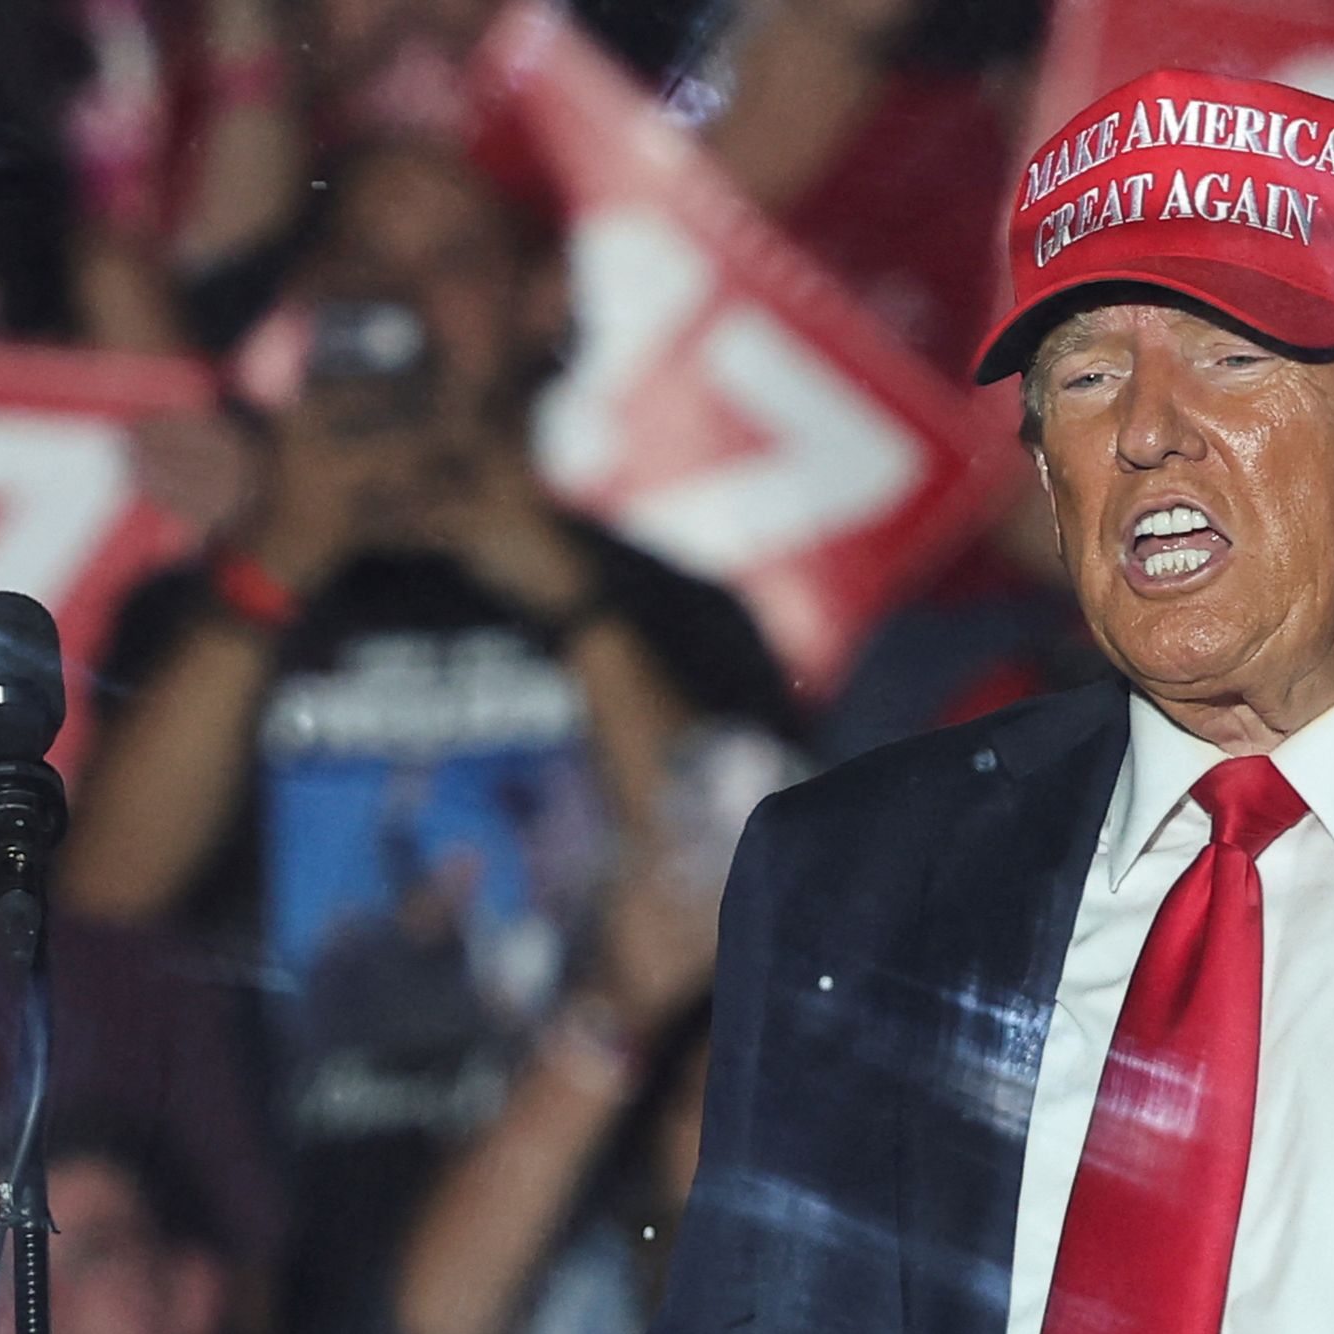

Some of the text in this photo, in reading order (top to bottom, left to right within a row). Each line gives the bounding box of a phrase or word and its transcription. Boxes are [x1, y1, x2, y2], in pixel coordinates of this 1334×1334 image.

[1020, 111, 1121, 211] MAKE
[1033, 168, 1319, 268] GREAT AGAIN
